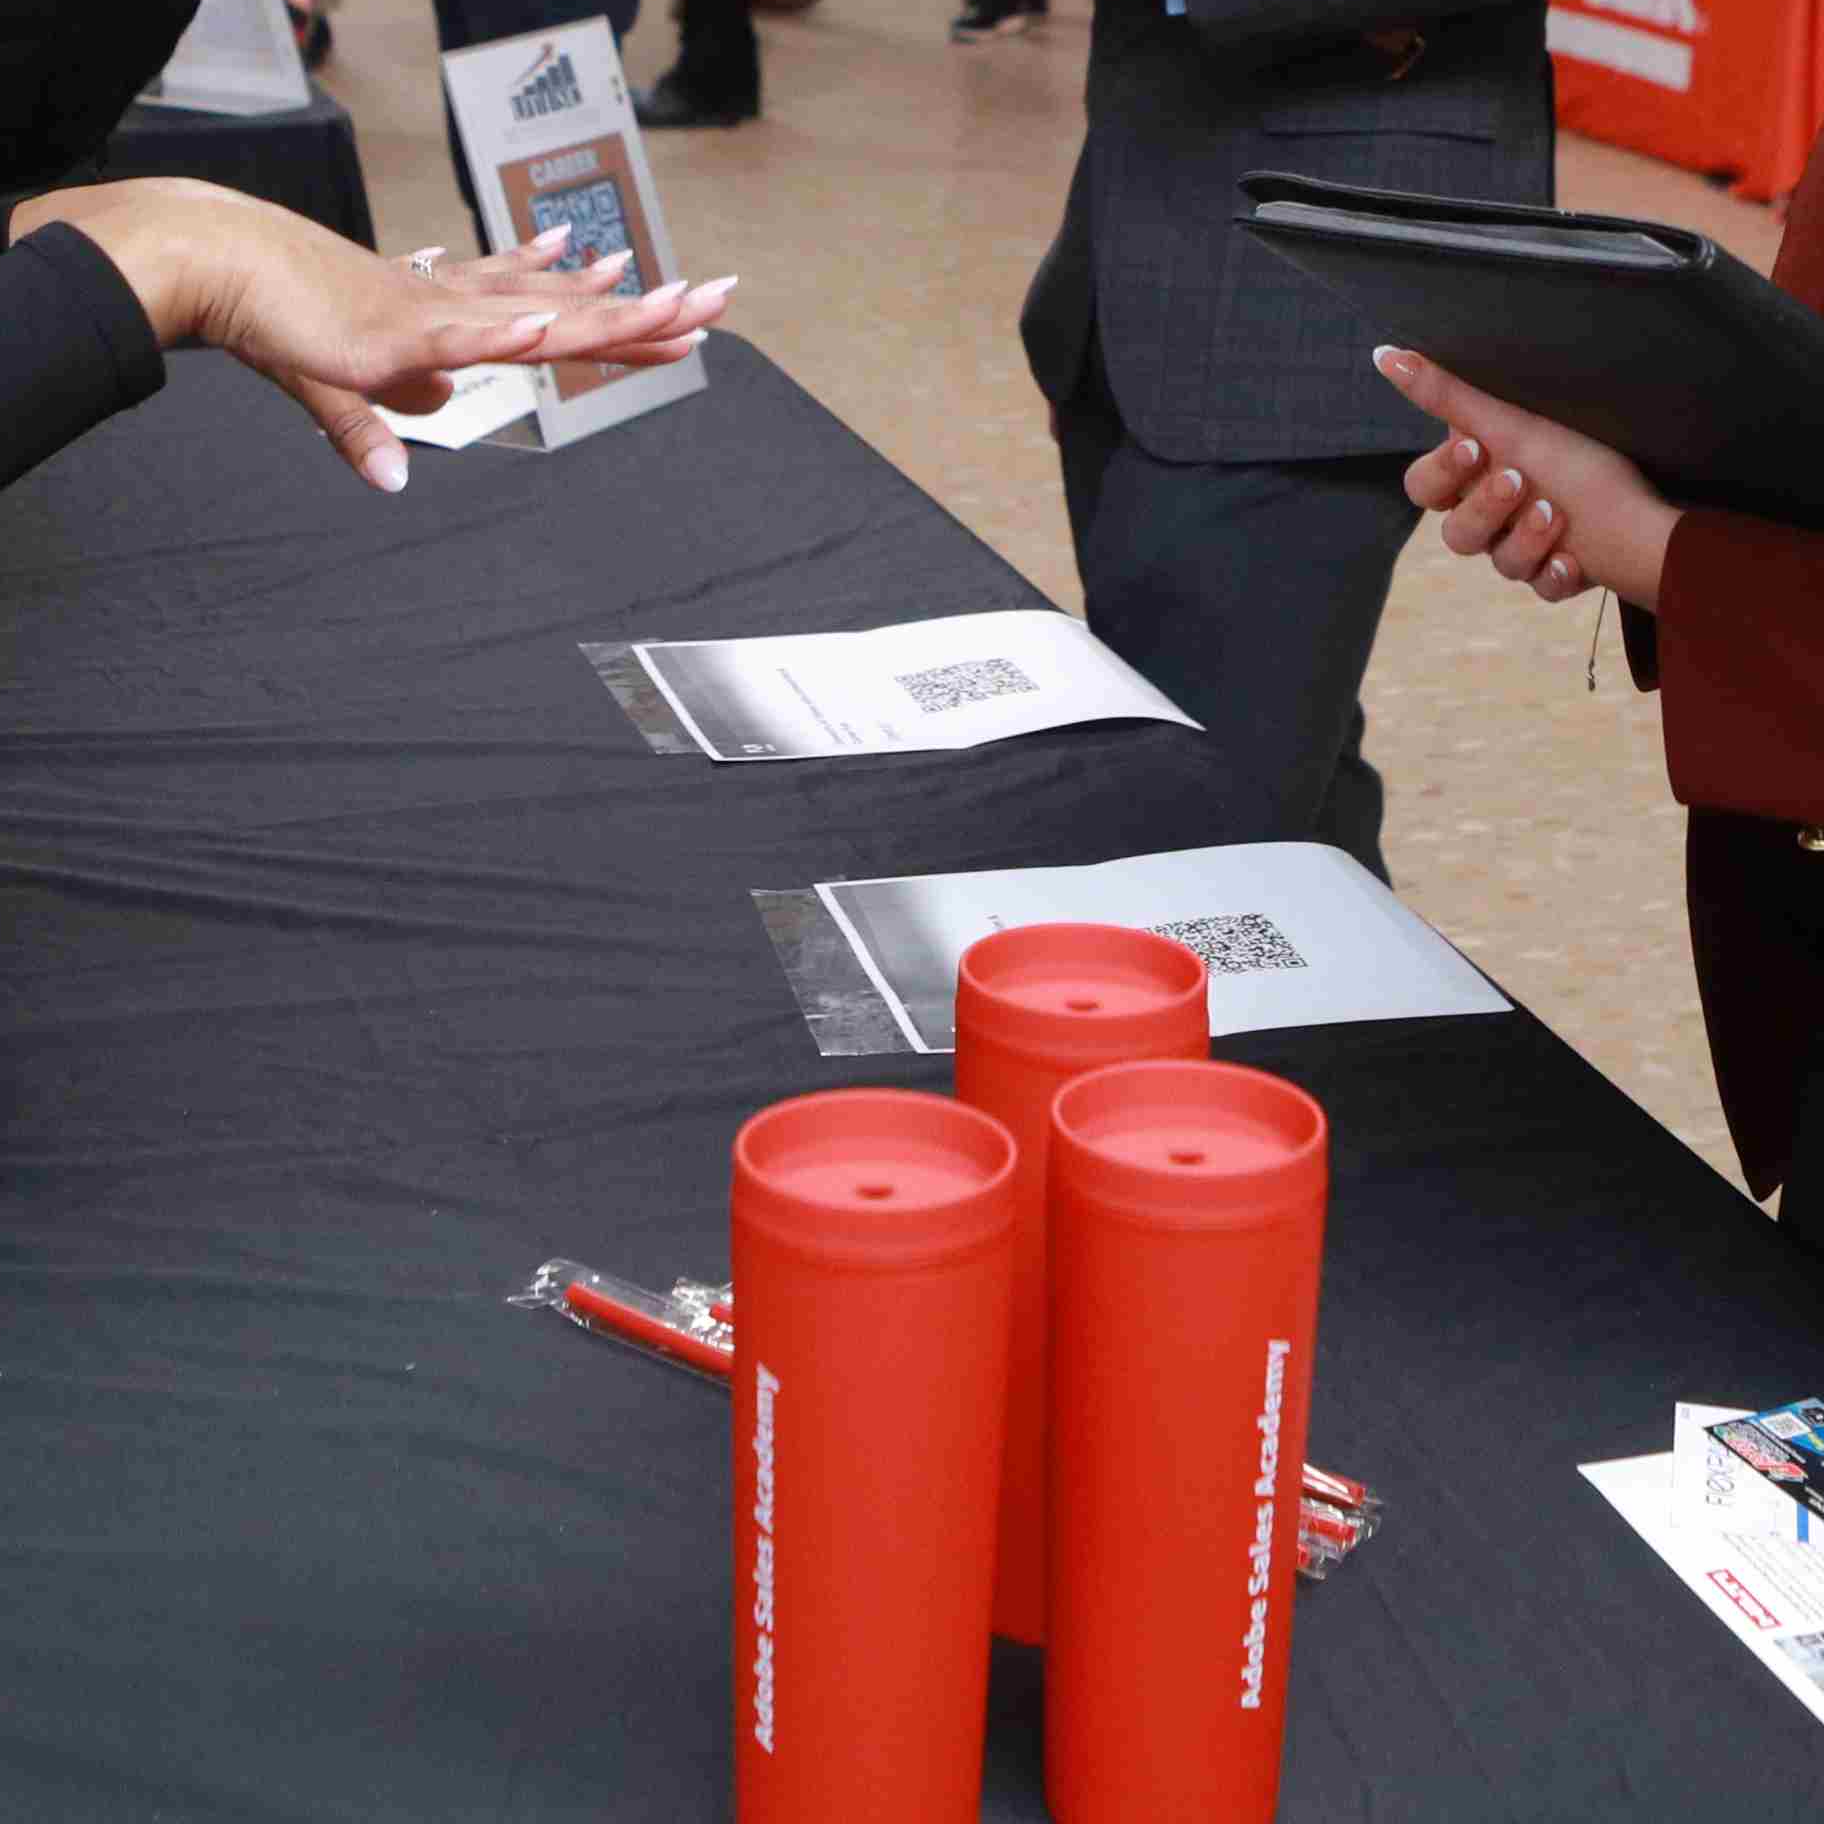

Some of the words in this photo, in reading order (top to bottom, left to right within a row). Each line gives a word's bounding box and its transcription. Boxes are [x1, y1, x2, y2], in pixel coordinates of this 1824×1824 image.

[753, 1360, 781, 1536] Academy
[1254, 1338, 1292, 1497] Academy
[752, 1536, 775, 1633] Sales
[1247, 1502, 1275, 1597] Sales
[753, 1633, 775, 1756] Adobe
[1240, 1598, 1269, 1709] Adobe
